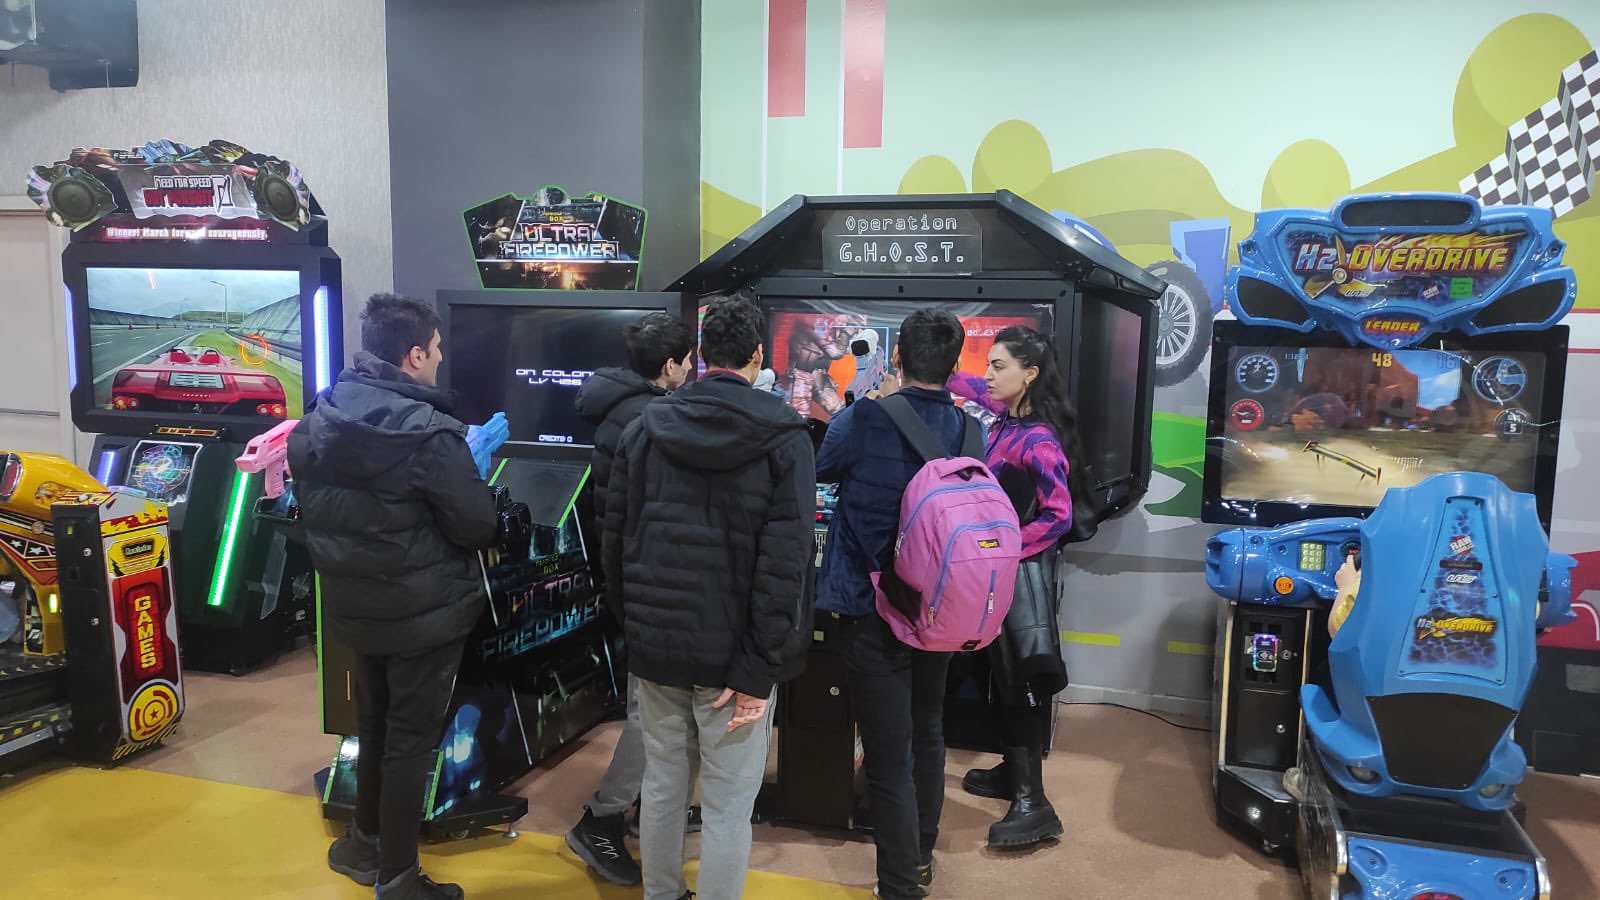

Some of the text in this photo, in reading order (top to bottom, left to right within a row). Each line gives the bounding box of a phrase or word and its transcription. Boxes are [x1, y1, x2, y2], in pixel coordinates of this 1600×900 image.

[845, 213, 957, 234] Operation
[524, 225, 592, 242] ULTRA
[502, 242, 616, 259] FIREPOWER
[839, 241, 965, 263] G.H.O.S.T.
[1295, 243, 1510, 272] H2 OVERDRIVE
[1364, 320, 1420, 333] LEADER
[1371, 352, 1393, 368] 48
[134, 595, 157, 669] GAMES
